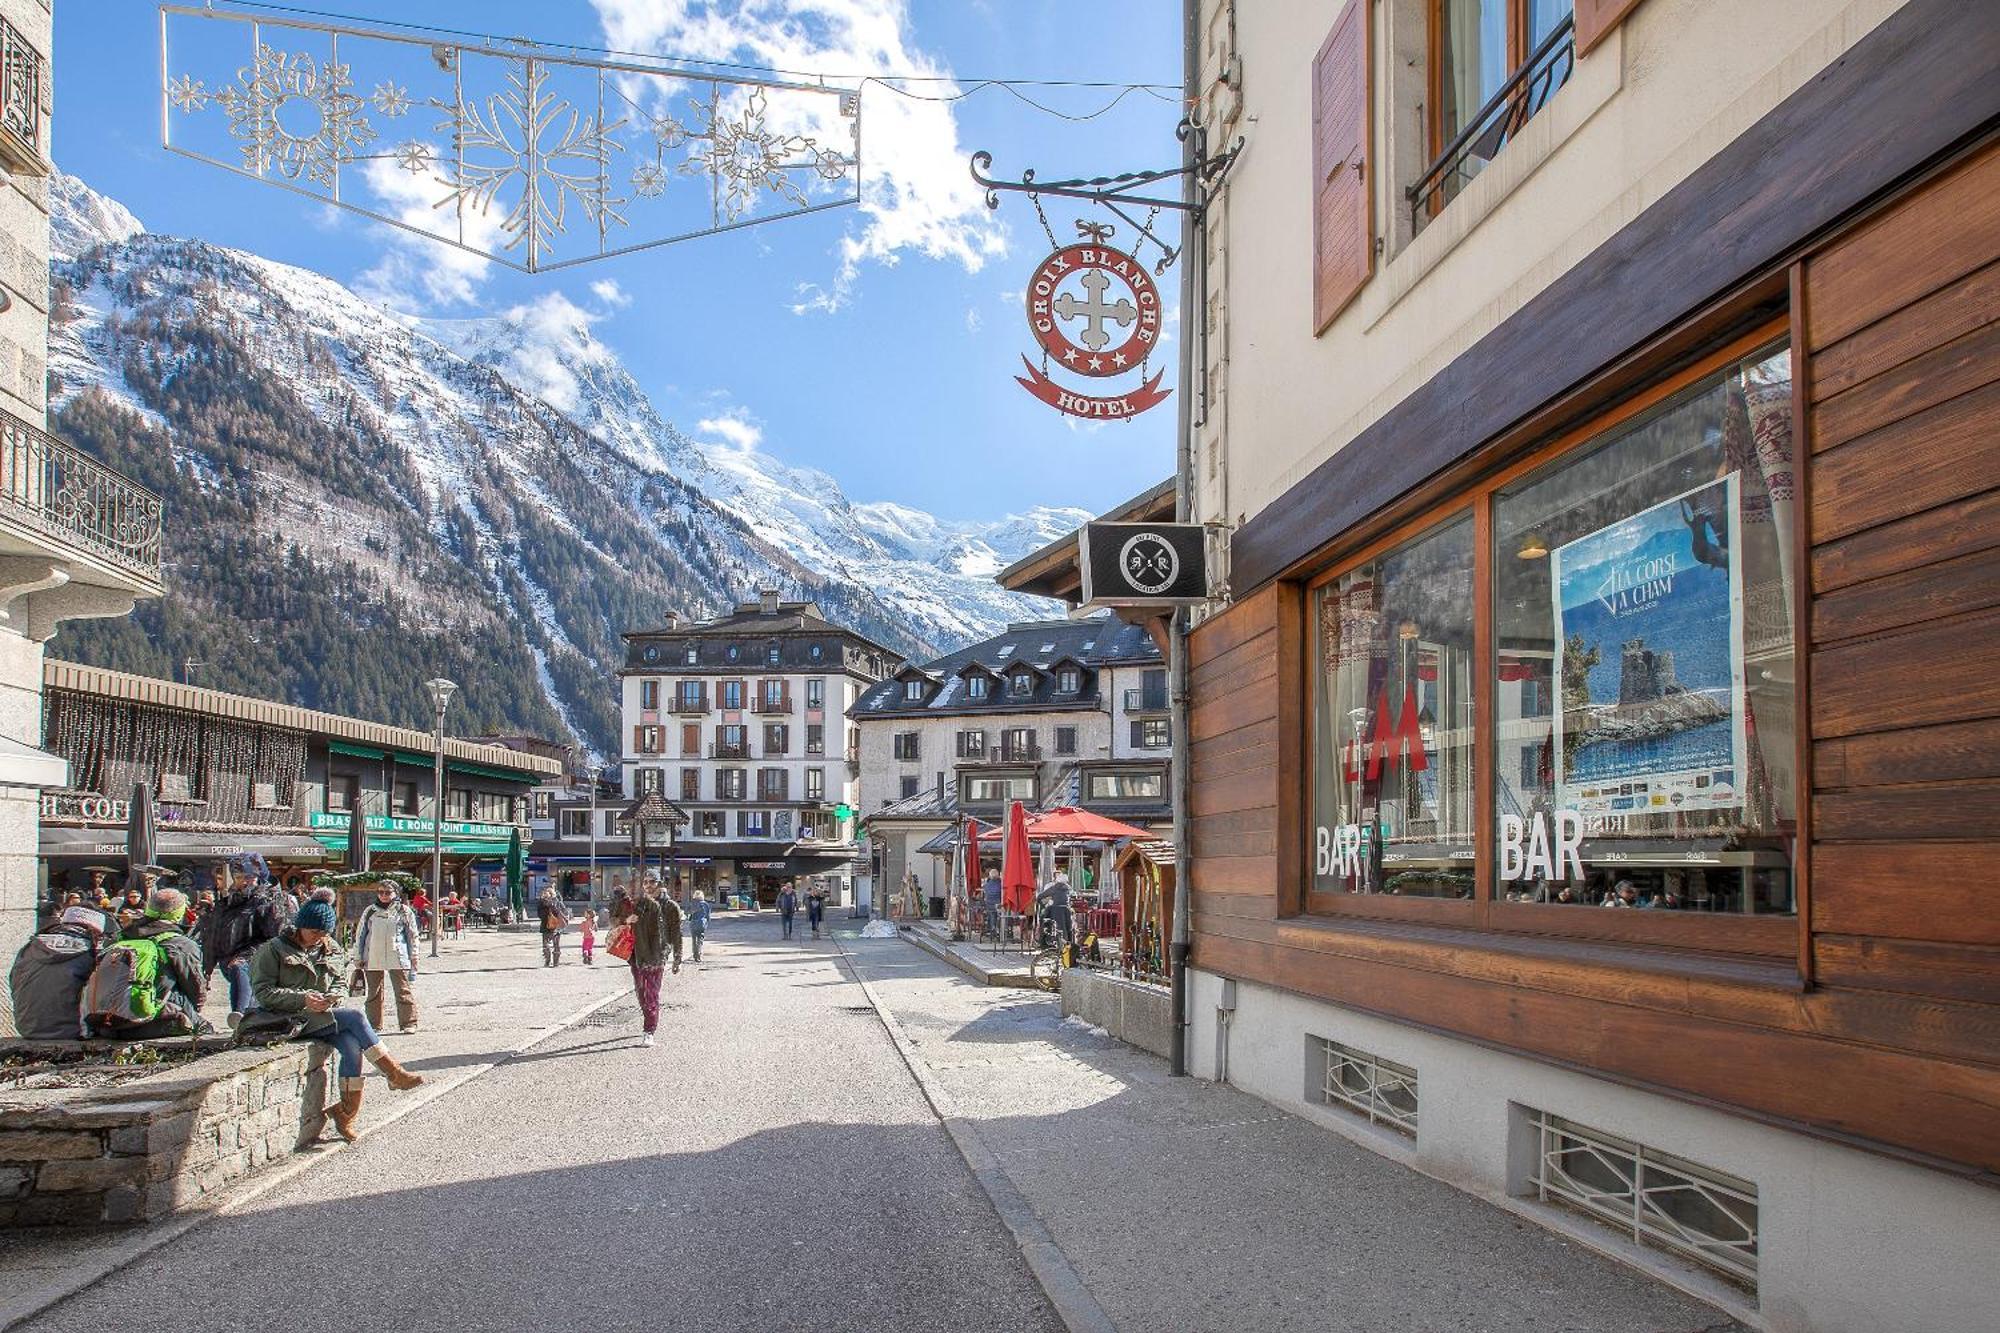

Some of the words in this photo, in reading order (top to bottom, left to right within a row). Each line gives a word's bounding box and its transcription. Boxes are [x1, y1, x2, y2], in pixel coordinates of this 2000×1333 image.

[1034, 255, 1071, 333] CROIX
[1080, 249, 1156, 344] BLANCHE
[1056, 391, 1135, 417] HOTEL
[392, 819, 404, 829] LE
[407, 820, 434, 830] ROND
[95, 844, 119, 853] IRISH
[1316, 823, 1361, 876] BAR
[1500, 809, 1585, 880] BAR
